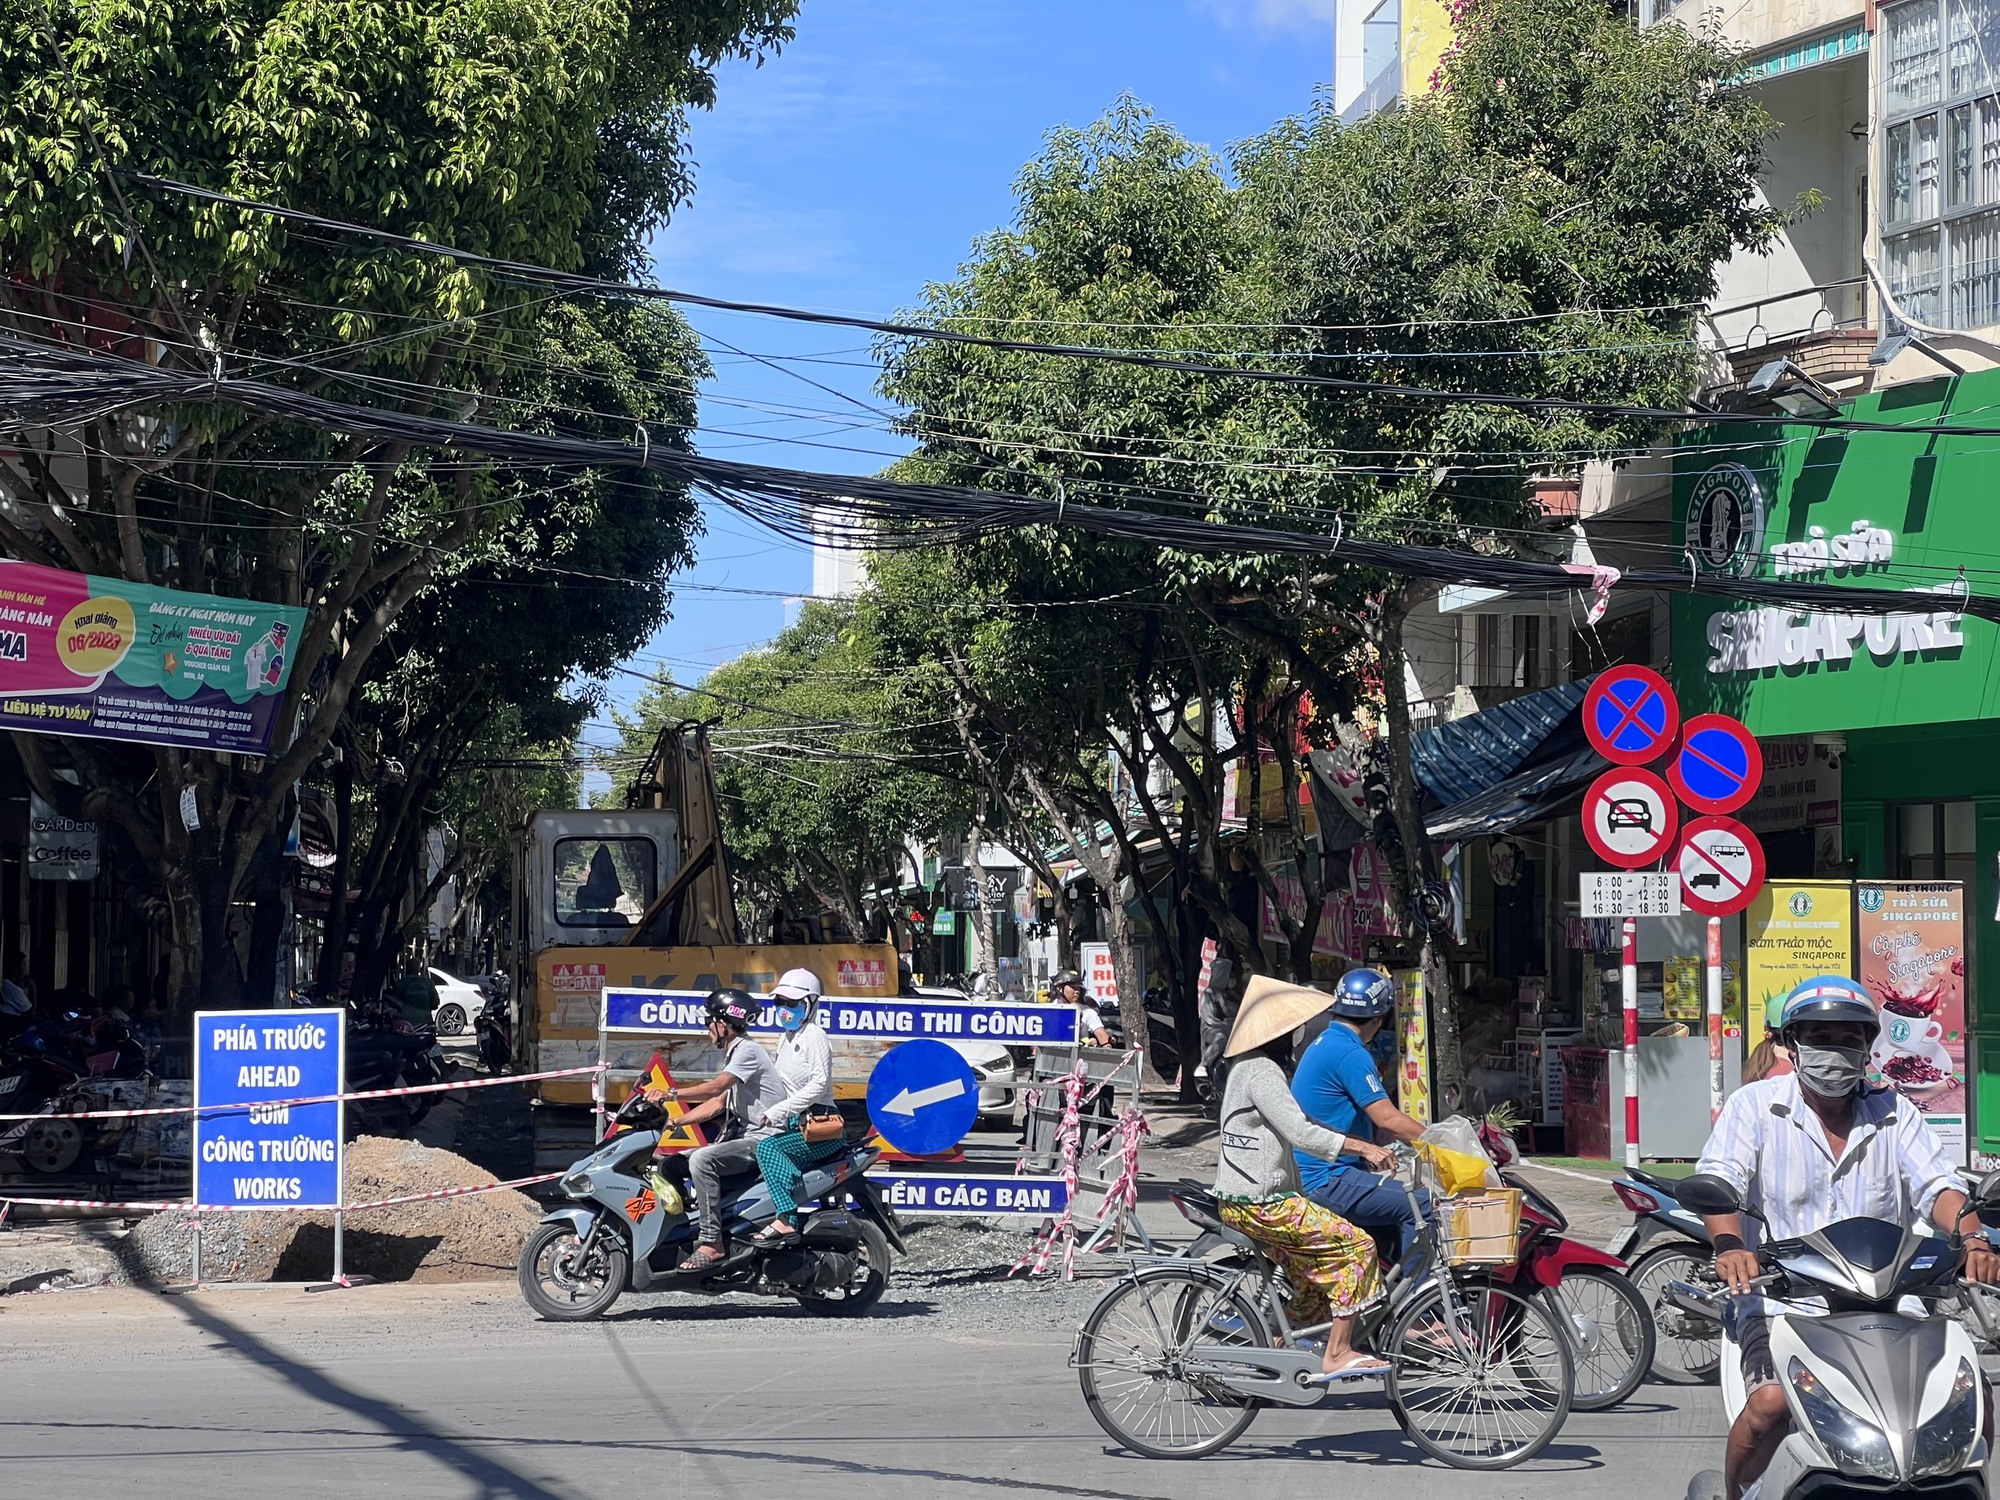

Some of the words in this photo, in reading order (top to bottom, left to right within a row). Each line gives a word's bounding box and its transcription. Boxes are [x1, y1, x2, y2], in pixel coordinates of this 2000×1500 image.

[1691, 472, 1751, 520] SINGAPORE
[1770, 526, 1829, 576] TRÀ
[1831, 520, 1893, 567] SỮA
[189, 608, 216, 621] NGAY
[235, 614, 256, 627] NAY
[1706, 582, 1964, 674] SINGAPORE
[67, 631, 122, 654] 06/2023
[4, 699, 29, 715] LIÊN
[31, 702, 47, 719] HỆ
[48, 704, 66, 718] TƯ
[65, 704, 90, 721] VẤN
[33, 818, 95, 832] GARDEN
[35, 846, 91, 861] Coffee
[987, 874, 1007, 891] ÂY
[1892, 894, 1918, 908] TRÀ
[1922, 896, 1948, 908] SỮA
[1882, 912, 1959, 921] SINGAPORE
[1872, 934, 1892, 956] Cà
[1894, 931, 1922, 957] phê
[1792, 952, 1847, 960] SINGAPORE
[1888, 945, 1957, 983] Singapore
[838, 1009, 913, 1032] ĐANG
[921, 1012, 962, 1033] THI
[970, 1011, 1043, 1035] CÔNG
[213, 1023, 257, 1051] PHÍA
[262, 1022, 326, 1050] TRƯỚC
[237, 1066, 300, 1088] AHEAD
[249, 1104, 289, 1125] 50M
[203, 1135, 254, 1163] CÔNG
[258, 1134, 334, 1162] TRƯỜNG
[233, 1177, 302, 1200] WORKS
[934, 1184, 988, 1207] CÁC
[995, 1188, 1051, 1211] BẠN
